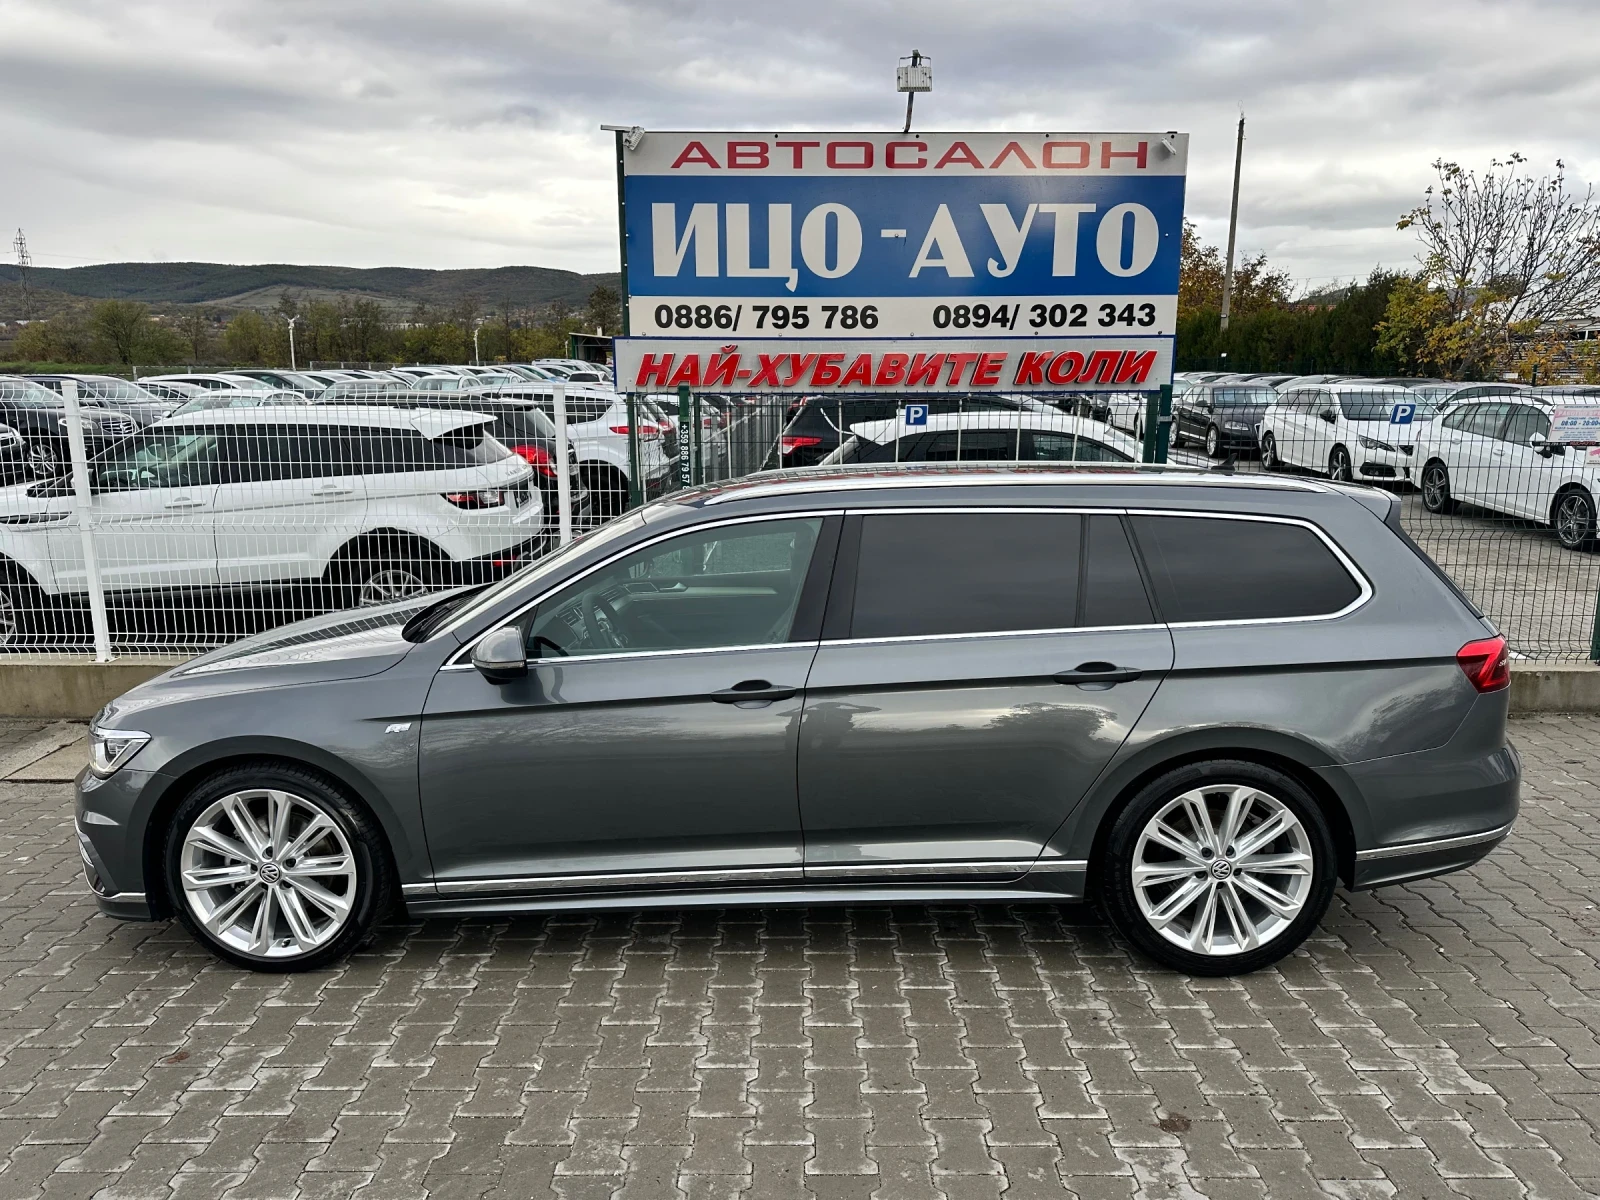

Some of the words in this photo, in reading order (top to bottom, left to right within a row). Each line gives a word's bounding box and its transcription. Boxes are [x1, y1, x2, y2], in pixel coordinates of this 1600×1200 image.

[671, 141, 1148, 169] АВТОСАЛОН
[654, 304, 742, 331] 0886/
[752, 305, 810, 329] 795
[821, 305, 879, 329] 786
[933, 303, 1020, 330] 0894/
[1029, 303, 1088, 328] 302
[1097, 303, 1156, 327] 343
[635, 344, 1008, 387] НАЙ-ХУБАВИТЕ
[1014, 350, 1157, 386] КОЛИ
[910, 406, 923, 423] P
[1394, 405, 1411, 422] P
[680, 424, 689, 444] +359
[680, 445, 689, 460] 886
[681, 461, 690, 472] 79
[682, 472, 690, 483] 57
